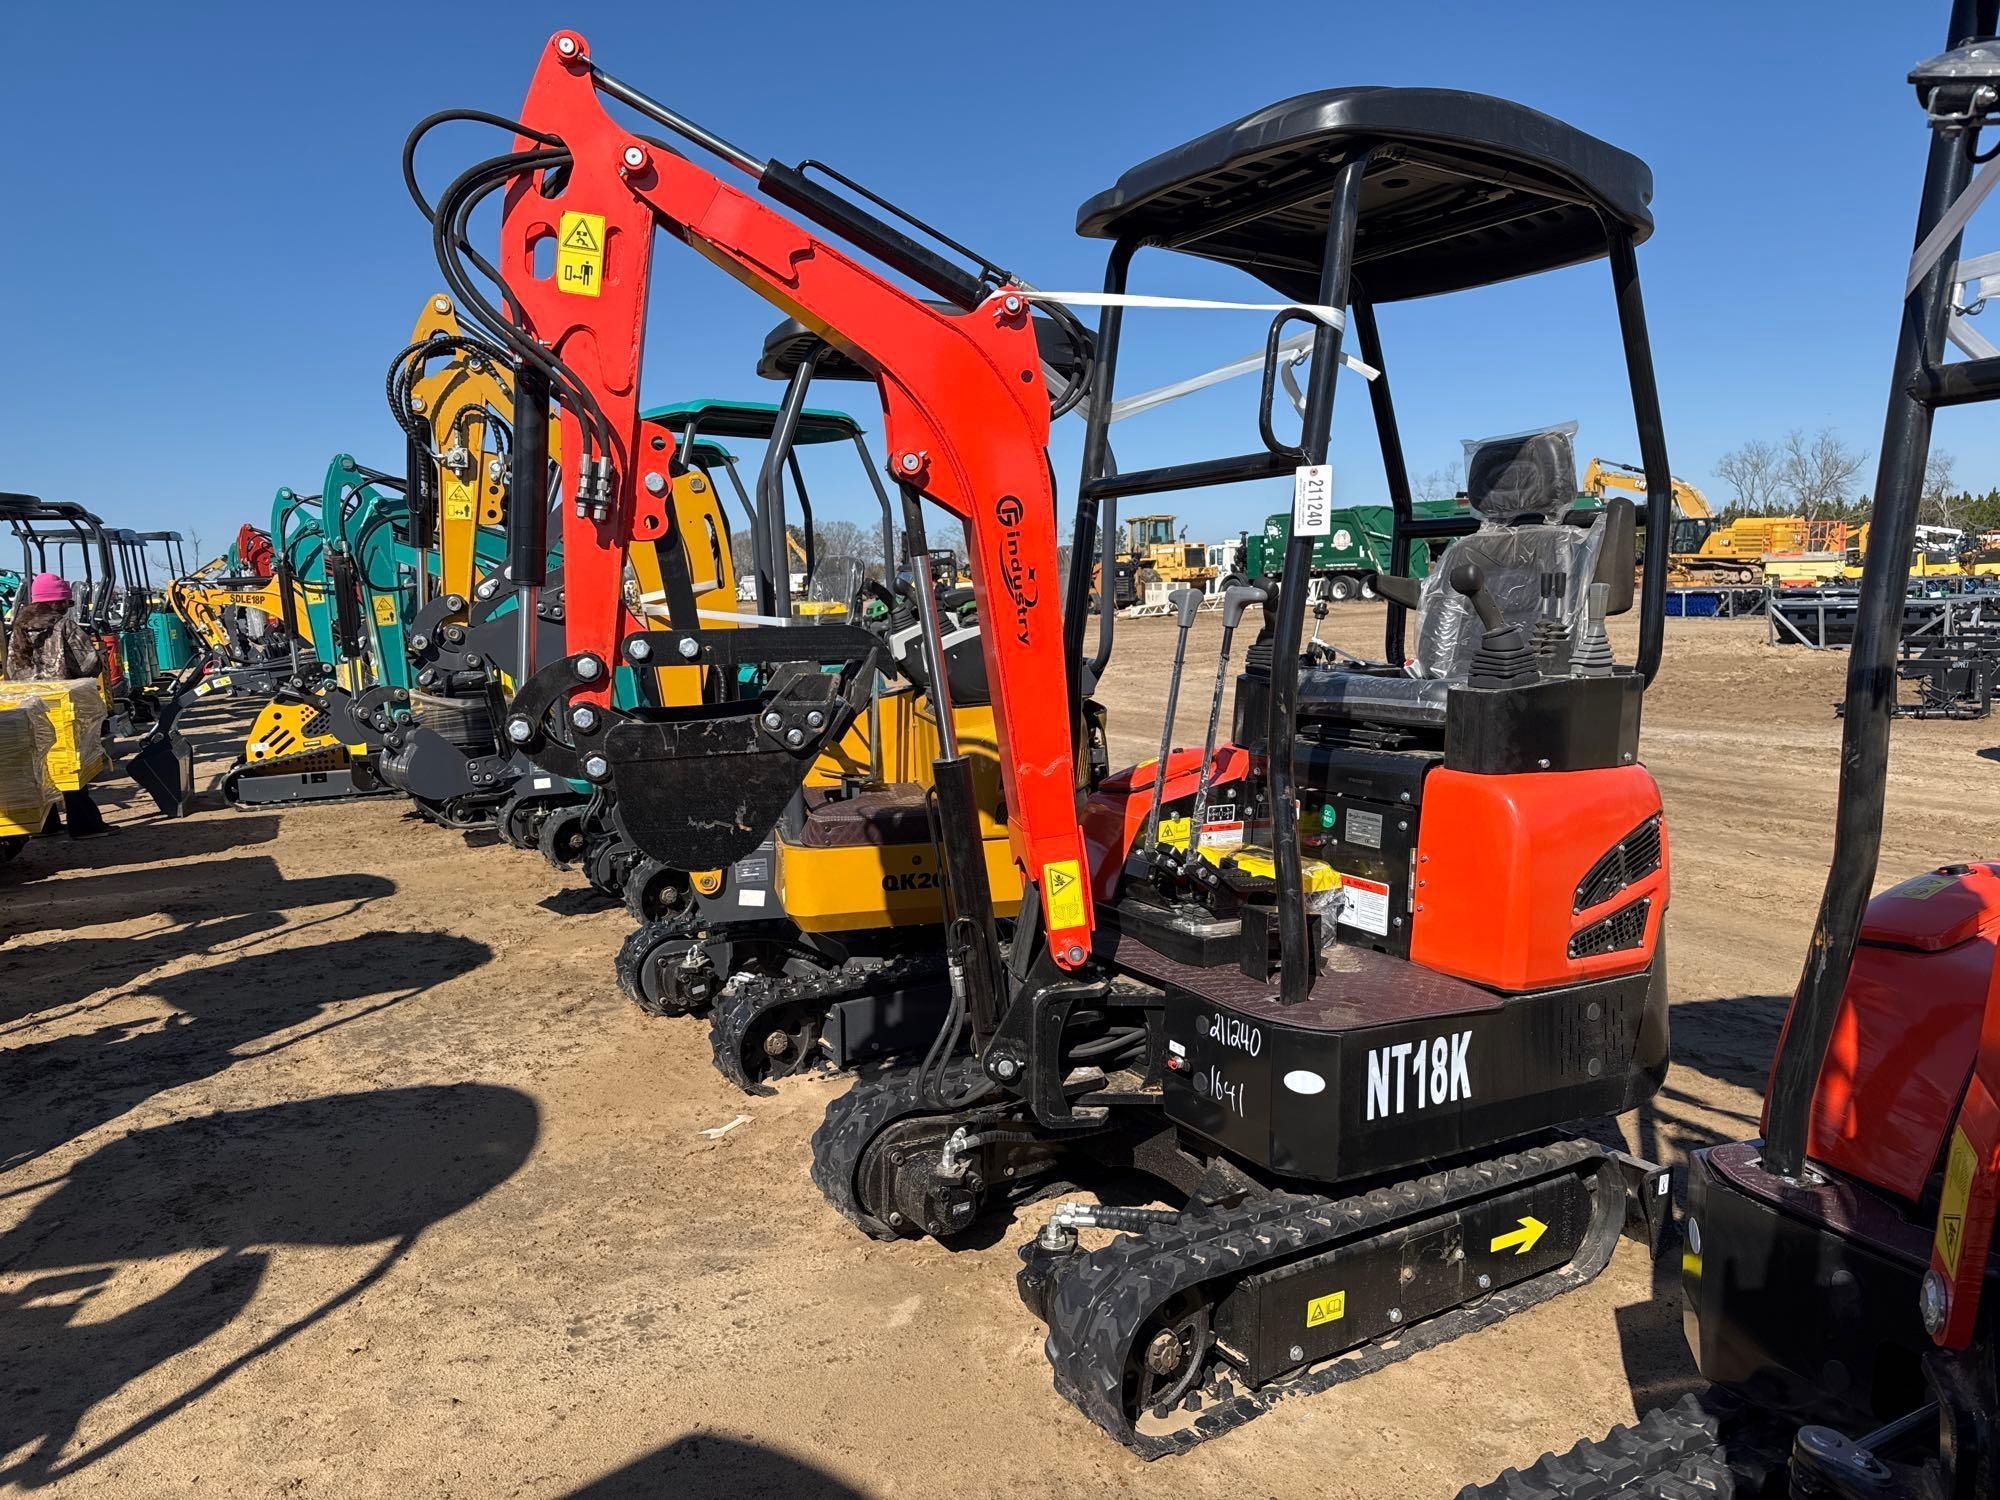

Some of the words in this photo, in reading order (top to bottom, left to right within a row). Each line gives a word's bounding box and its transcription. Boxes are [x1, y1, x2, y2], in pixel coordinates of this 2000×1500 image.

[1307, 480, 1324, 526] 211240
[230, 594, 265, 604] SDLE18P
[1209, 1013, 1261, 1057] 211240
[1210, 1065, 1244, 1118] 1641
[1366, 1030, 1473, 1121] NT18K
